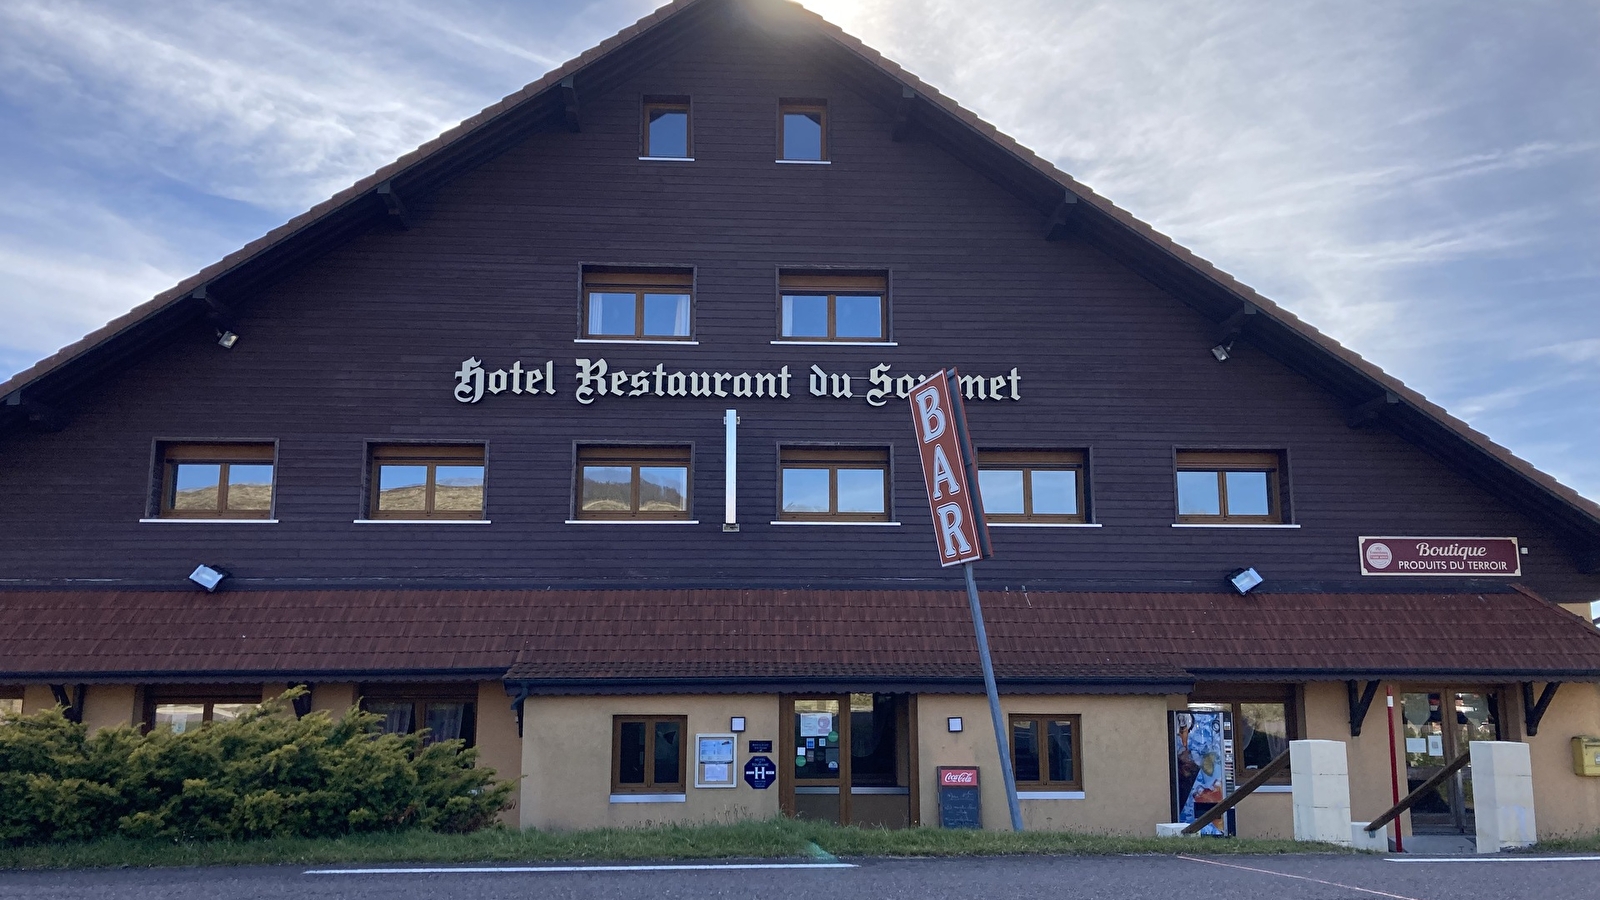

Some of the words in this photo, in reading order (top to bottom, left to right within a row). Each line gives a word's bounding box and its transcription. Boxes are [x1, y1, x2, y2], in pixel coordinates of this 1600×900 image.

[454, 356, 557, 404] Hotel
[575, 358, 792, 404] Restaurant
[809, 363, 853, 398] du
[866, 362, 1021, 406] Somet
[915, 385, 972, 558] BAR
[1398, 560, 1447, 570] PRODUITS
[1449, 560, 1465, 570] DU
[1467, 561, 1508, 570] TERROIR
[1416, 542, 1487, 560] Boutique
